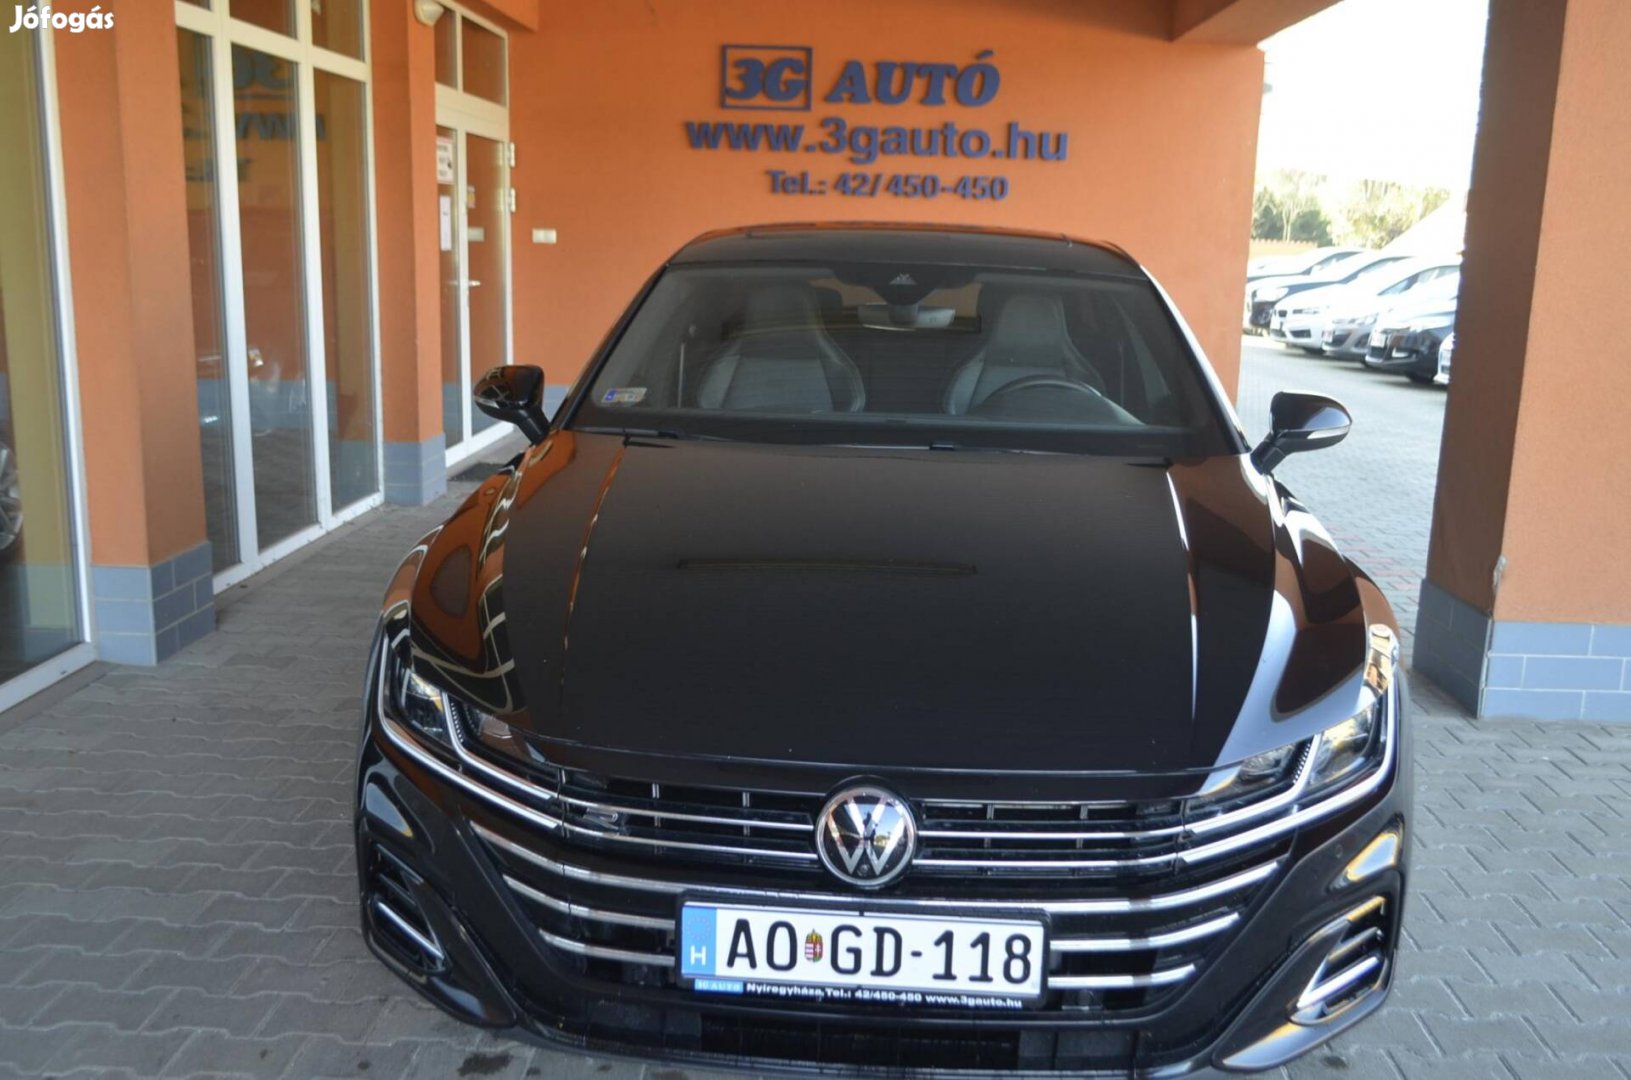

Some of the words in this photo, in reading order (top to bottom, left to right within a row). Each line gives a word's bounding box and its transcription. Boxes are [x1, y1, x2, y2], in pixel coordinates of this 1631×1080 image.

[724, 58, 808, 101] 3G
[823, 50, 1000, 107] AUTÓ
[685, 117, 1068, 164] www.3gauto.hu
[767, 170, 827, 195] Tel.:
[690, 945, 706, 966] H
